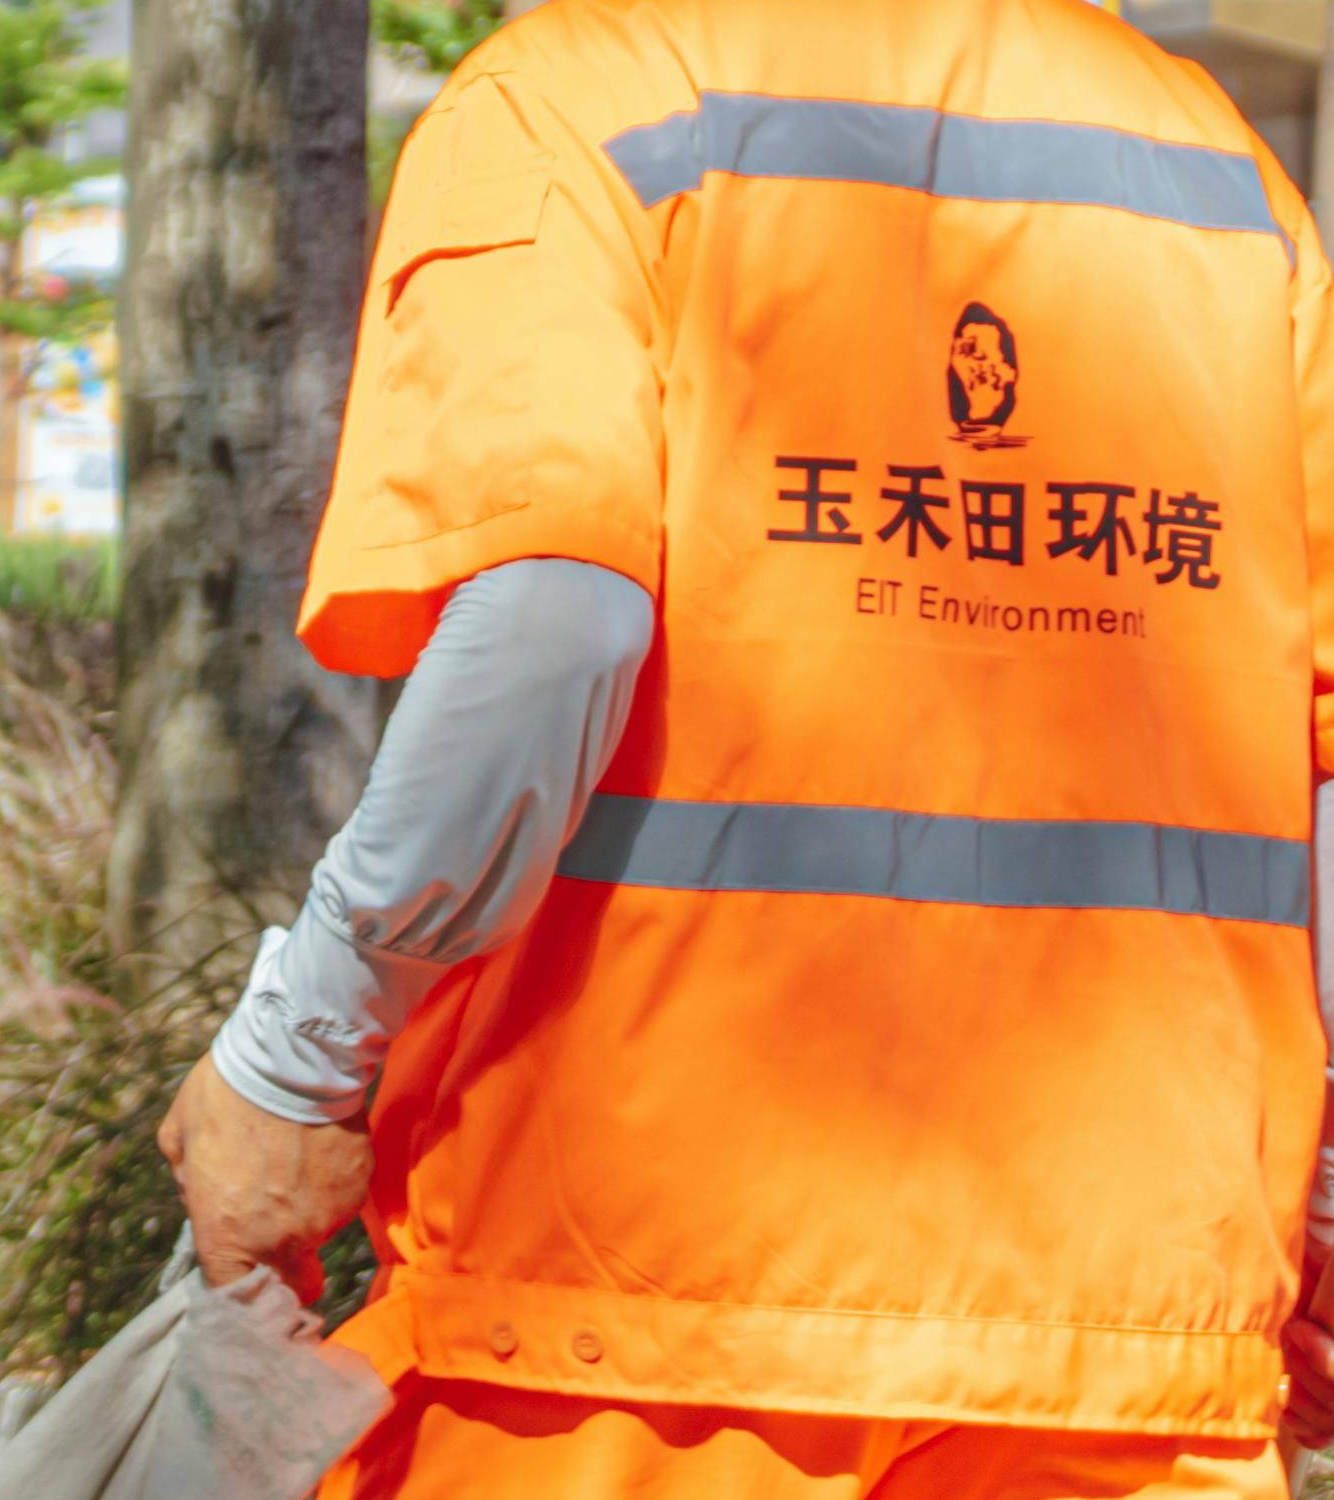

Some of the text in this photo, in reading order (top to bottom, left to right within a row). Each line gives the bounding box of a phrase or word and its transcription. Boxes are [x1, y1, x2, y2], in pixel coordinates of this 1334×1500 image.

[767, 455, 1222, 590] 玉禾田环境
[856, 577, 1147, 639] EIT Environment
